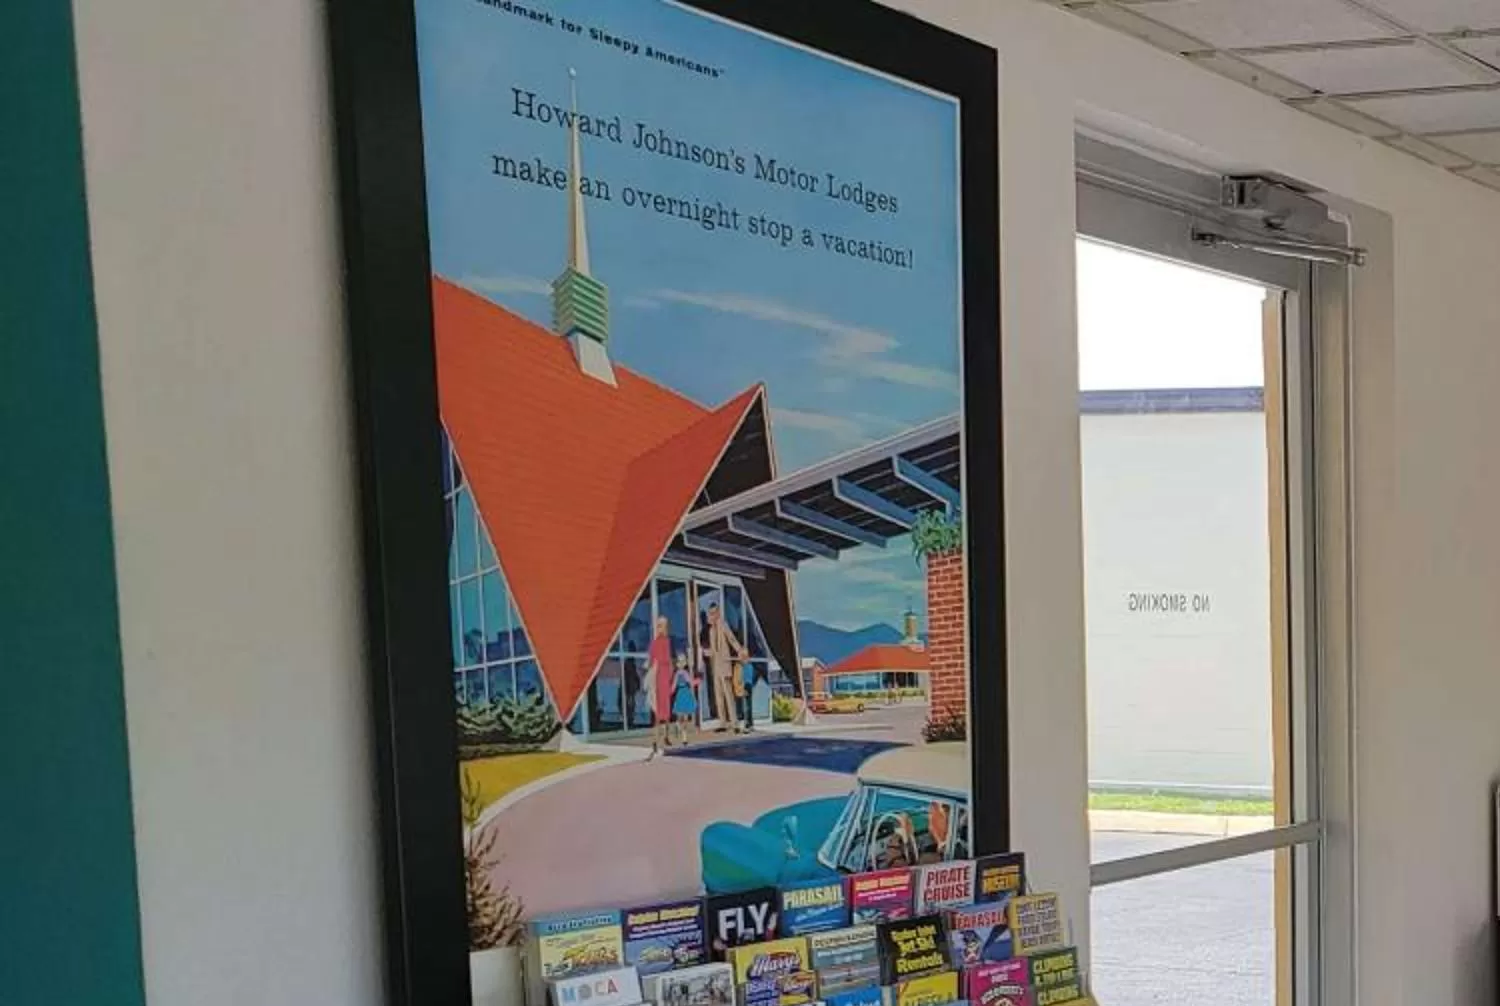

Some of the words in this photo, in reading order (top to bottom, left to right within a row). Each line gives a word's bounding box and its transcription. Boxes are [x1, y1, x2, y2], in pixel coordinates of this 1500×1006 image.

[476, 0, 555, 27] andmark
[560, 18, 582, 35] for
[589, 28, 640, 54] Sleepy
[511, 87, 622, 144] Howard
[632, 123, 746, 175] Johnson's
[754, 154, 819, 195] Motor
[826, 173, 899, 215] Lodges
[491, 152, 567, 193] make
[579, 175, 611, 203] an
[622, 185, 740, 231] overnight
[748, 216, 794, 248] stop
[801, 227, 814, 248] a
[822, 231, 915, 270] vacation!
[922, 881, 971, 903] CRUISE
[926, 864, 971, 887] PIRATE
[718, 902, 770, 941] FLY
[560, 977, 619, 1002] MOCA
